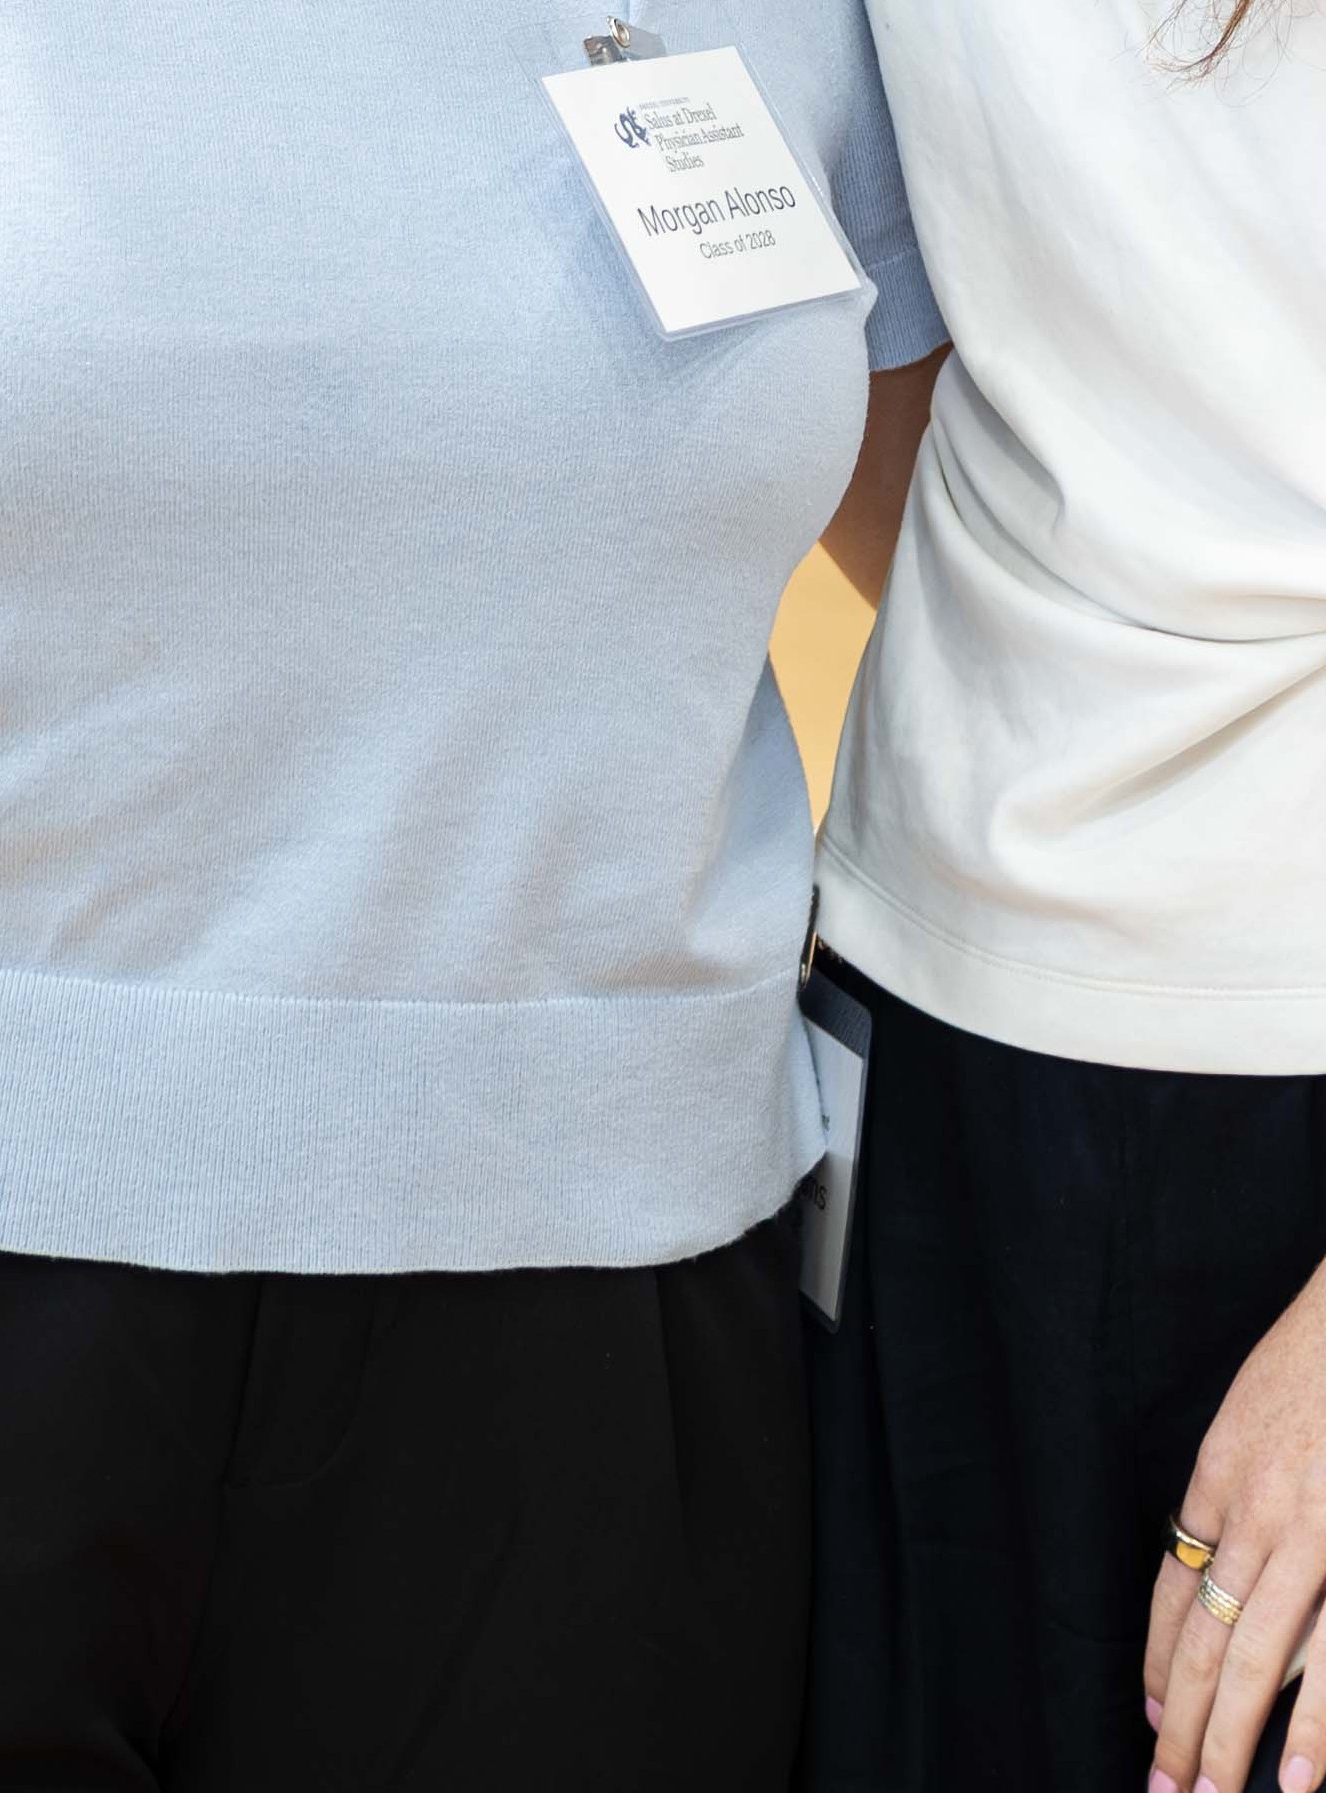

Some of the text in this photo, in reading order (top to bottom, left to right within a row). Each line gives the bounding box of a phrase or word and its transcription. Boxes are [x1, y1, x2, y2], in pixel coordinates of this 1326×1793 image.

[645, 111, 674, 130] Salus
[672, 112, 685, 127] at
[681, 102, 718, 124] Drexel
[654, 123, 745, 154] Physician Assistant
[665, 151, 705, 173] Studies
[637, 186, 796, 236] Morgan Alonso
[699, 229, 776, 260] Class of 2028
